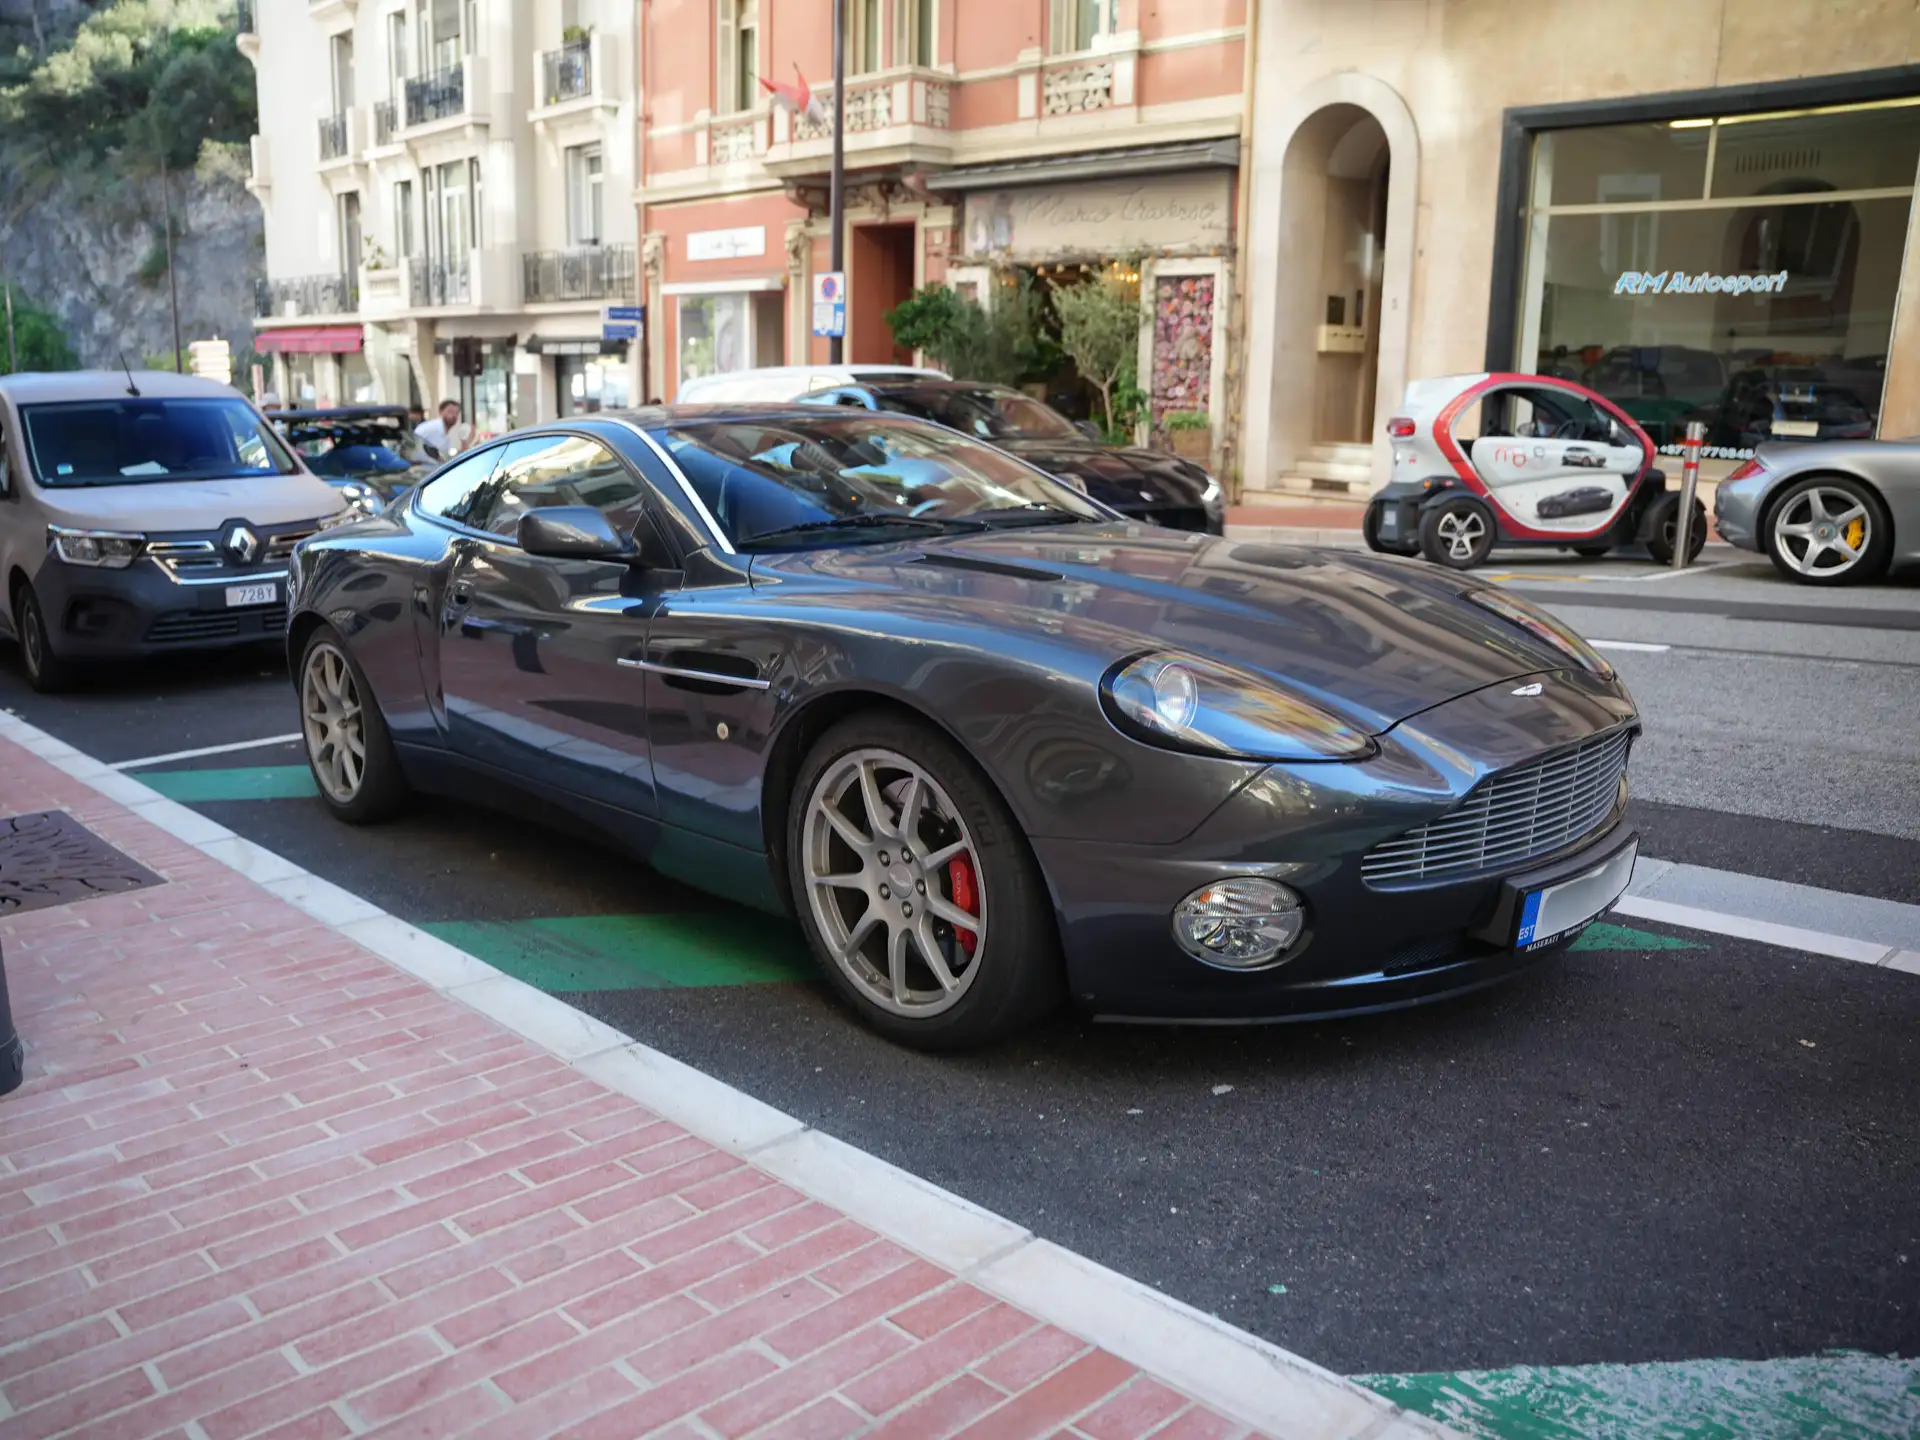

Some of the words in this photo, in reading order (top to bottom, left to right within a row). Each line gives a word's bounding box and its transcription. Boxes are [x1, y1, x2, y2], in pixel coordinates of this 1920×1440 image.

[1614, 270, 1669, 295] RM
[1664, 270, 1788, 296] Autosport
[240, 587, 272, 602] 728Y
[1518, 924, 1535, 939] EST
[1525, 934, 1559, 952] MASERATI
